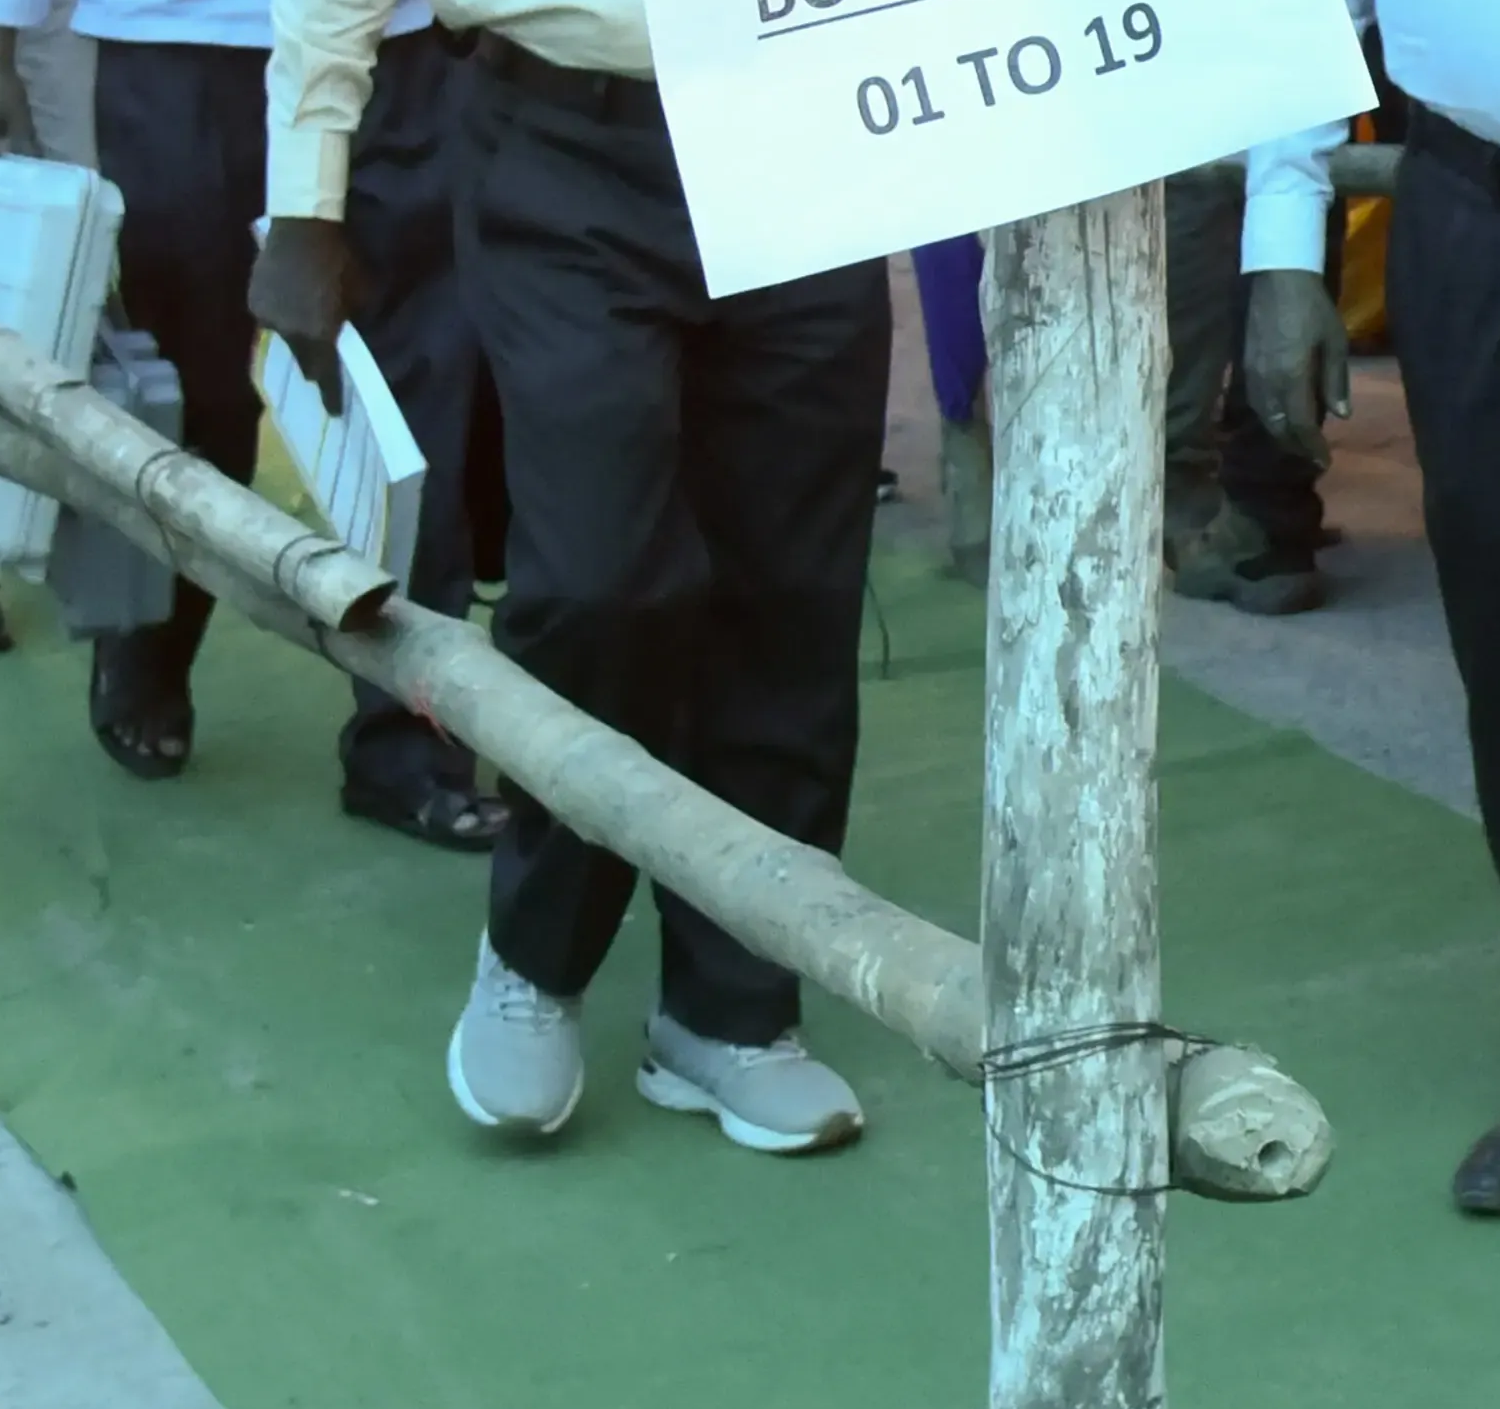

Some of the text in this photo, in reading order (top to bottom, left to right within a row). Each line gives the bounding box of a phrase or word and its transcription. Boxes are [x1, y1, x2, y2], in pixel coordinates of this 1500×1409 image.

[856, 1, 1163, 136] 01 TO 19
